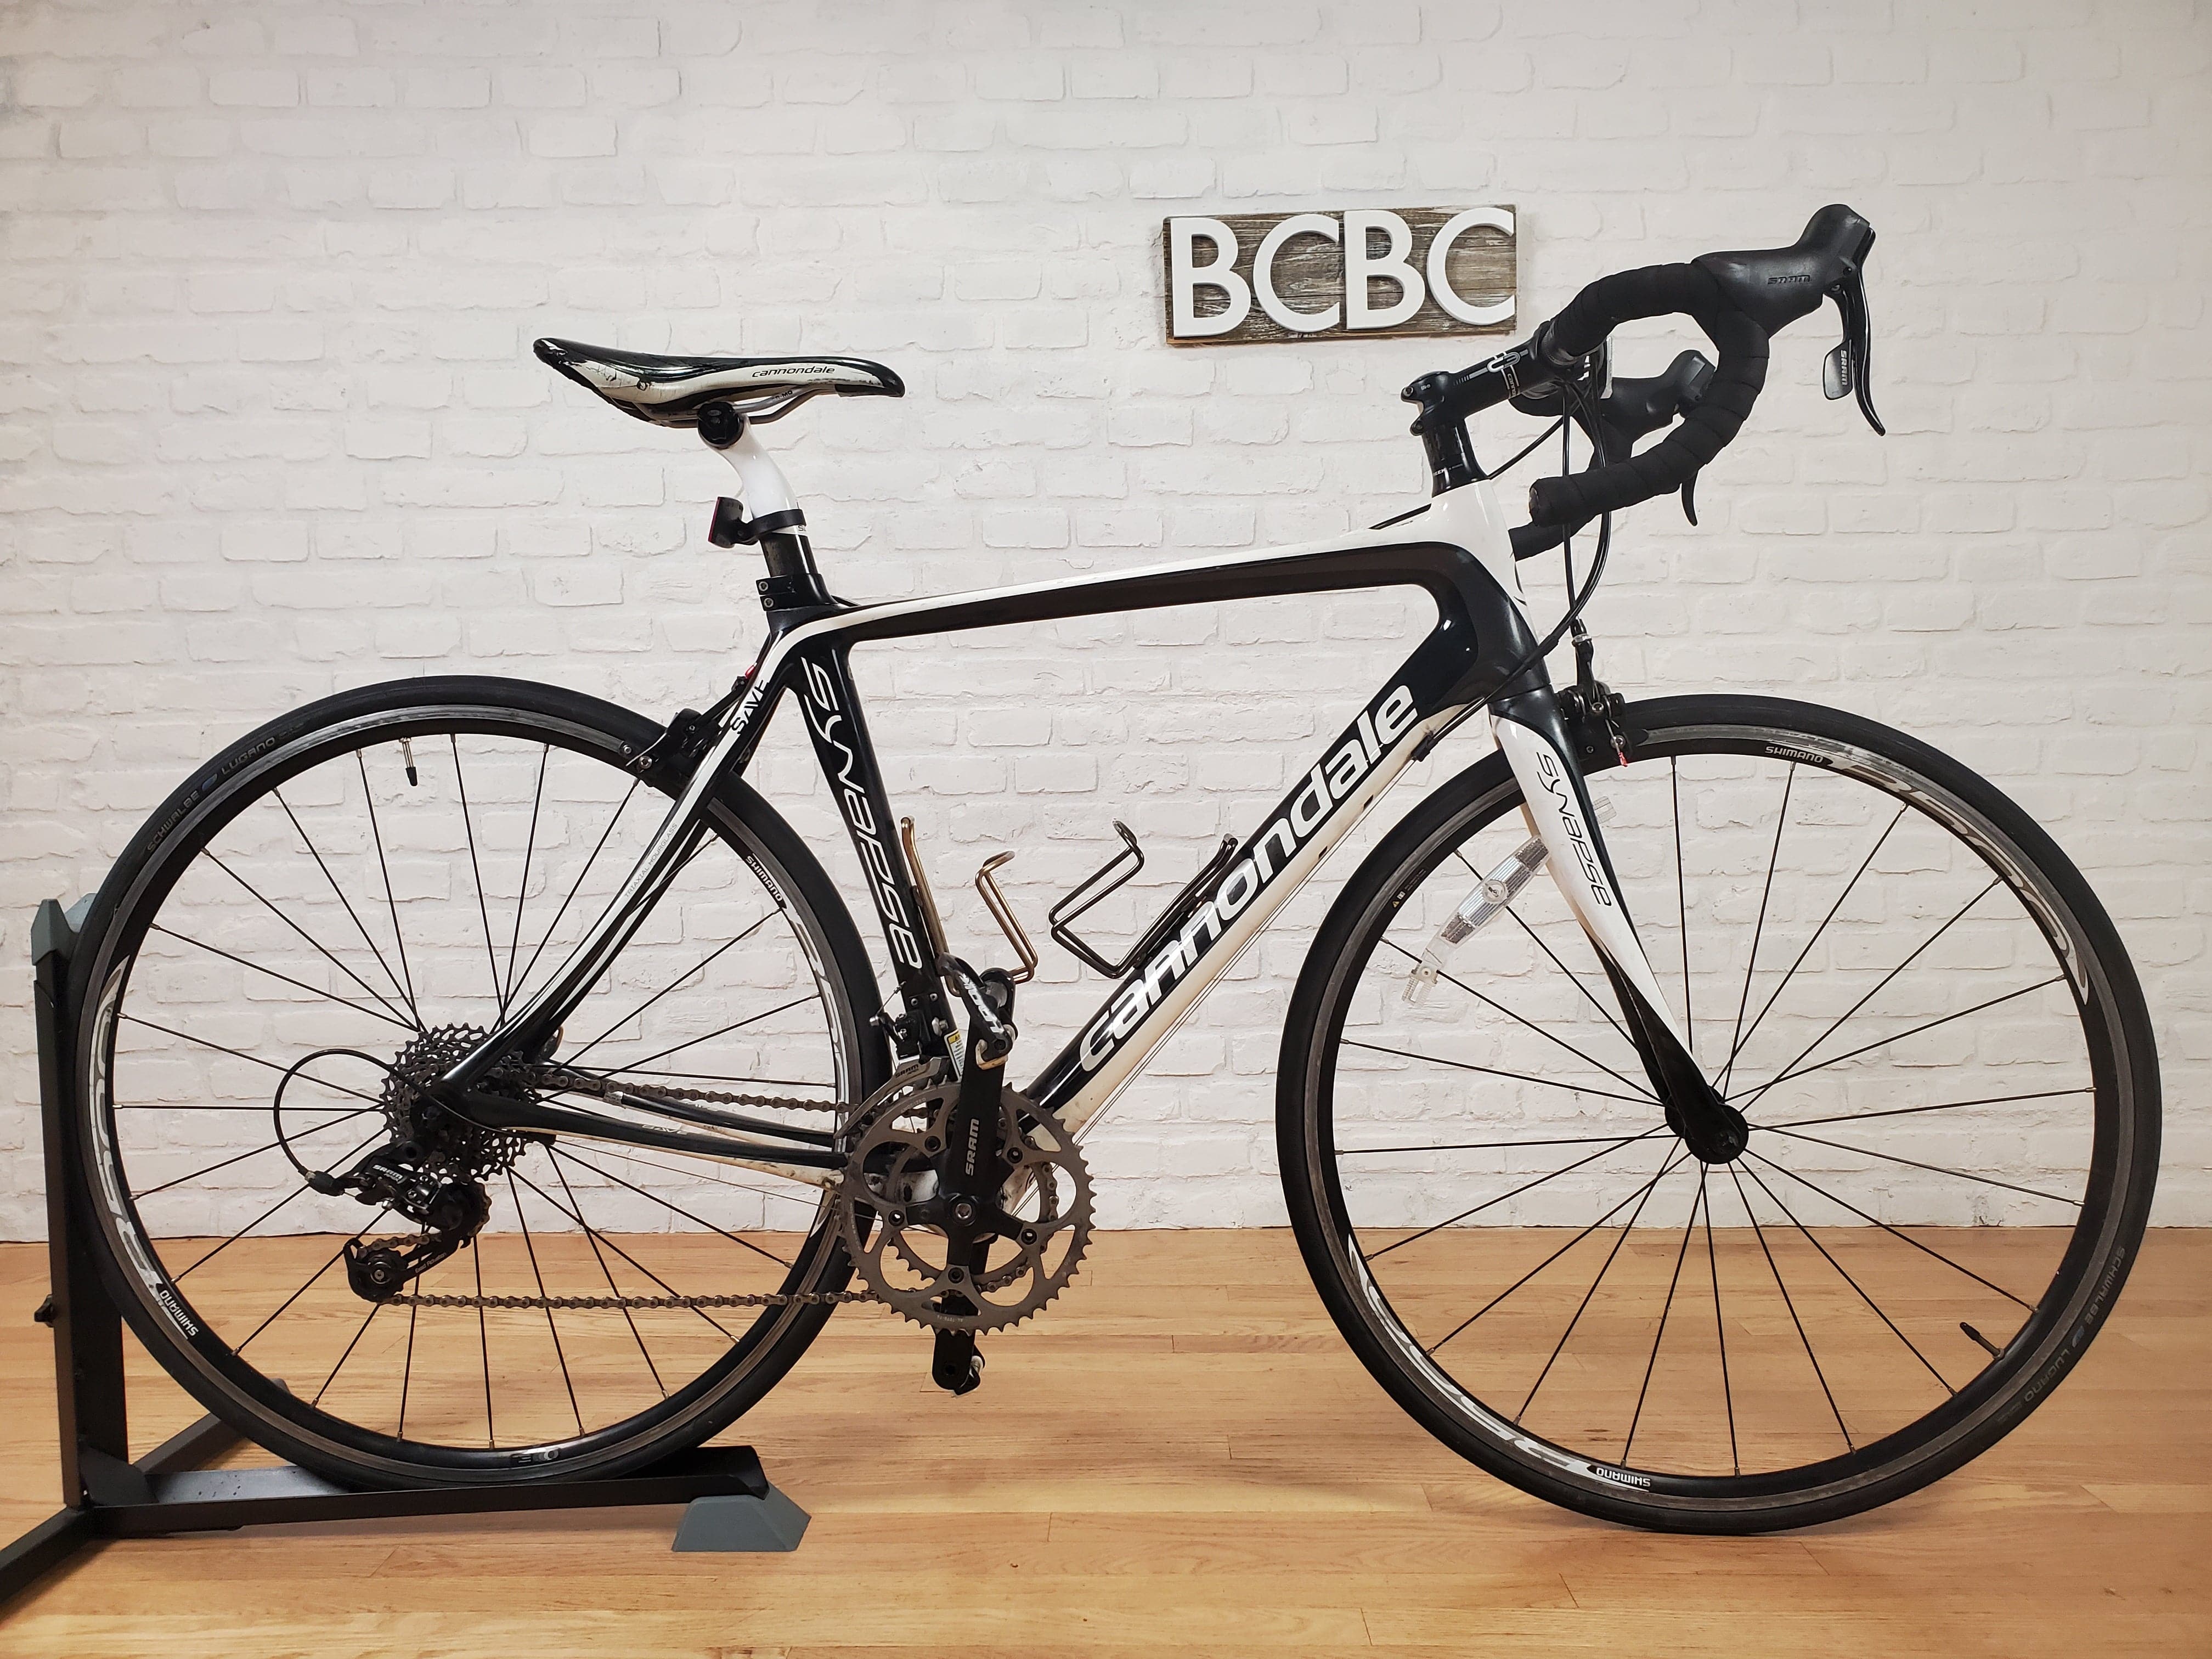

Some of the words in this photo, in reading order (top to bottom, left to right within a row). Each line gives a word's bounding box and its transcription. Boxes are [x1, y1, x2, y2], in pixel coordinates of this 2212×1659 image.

[1171, 207, 1516, 337] BCBC
[1768, 274, 1813, 285] SRAM
[752, 366, 835, 378] cannondale
[1840, 348, 1849, 386] SRAM
[1764, 745, 1823, 763] SHIMANO
[147, 791, 201, 852] SCHWALBE
[221, 736, 275, 774] LUGANO
[648, 823, 678, 866] HOURGLASS
[745, 854, 783, 902] SHIMANO
[1079, 685, 1418, 1071] cannondale
[964, 1117, 980, 1176] SRAM
[373, 1164, 403, 1180] SRAM
[159, 1289, 199, 1337] SHIMANO
[1595, 1467, 1651, 1488] SHIMANO
